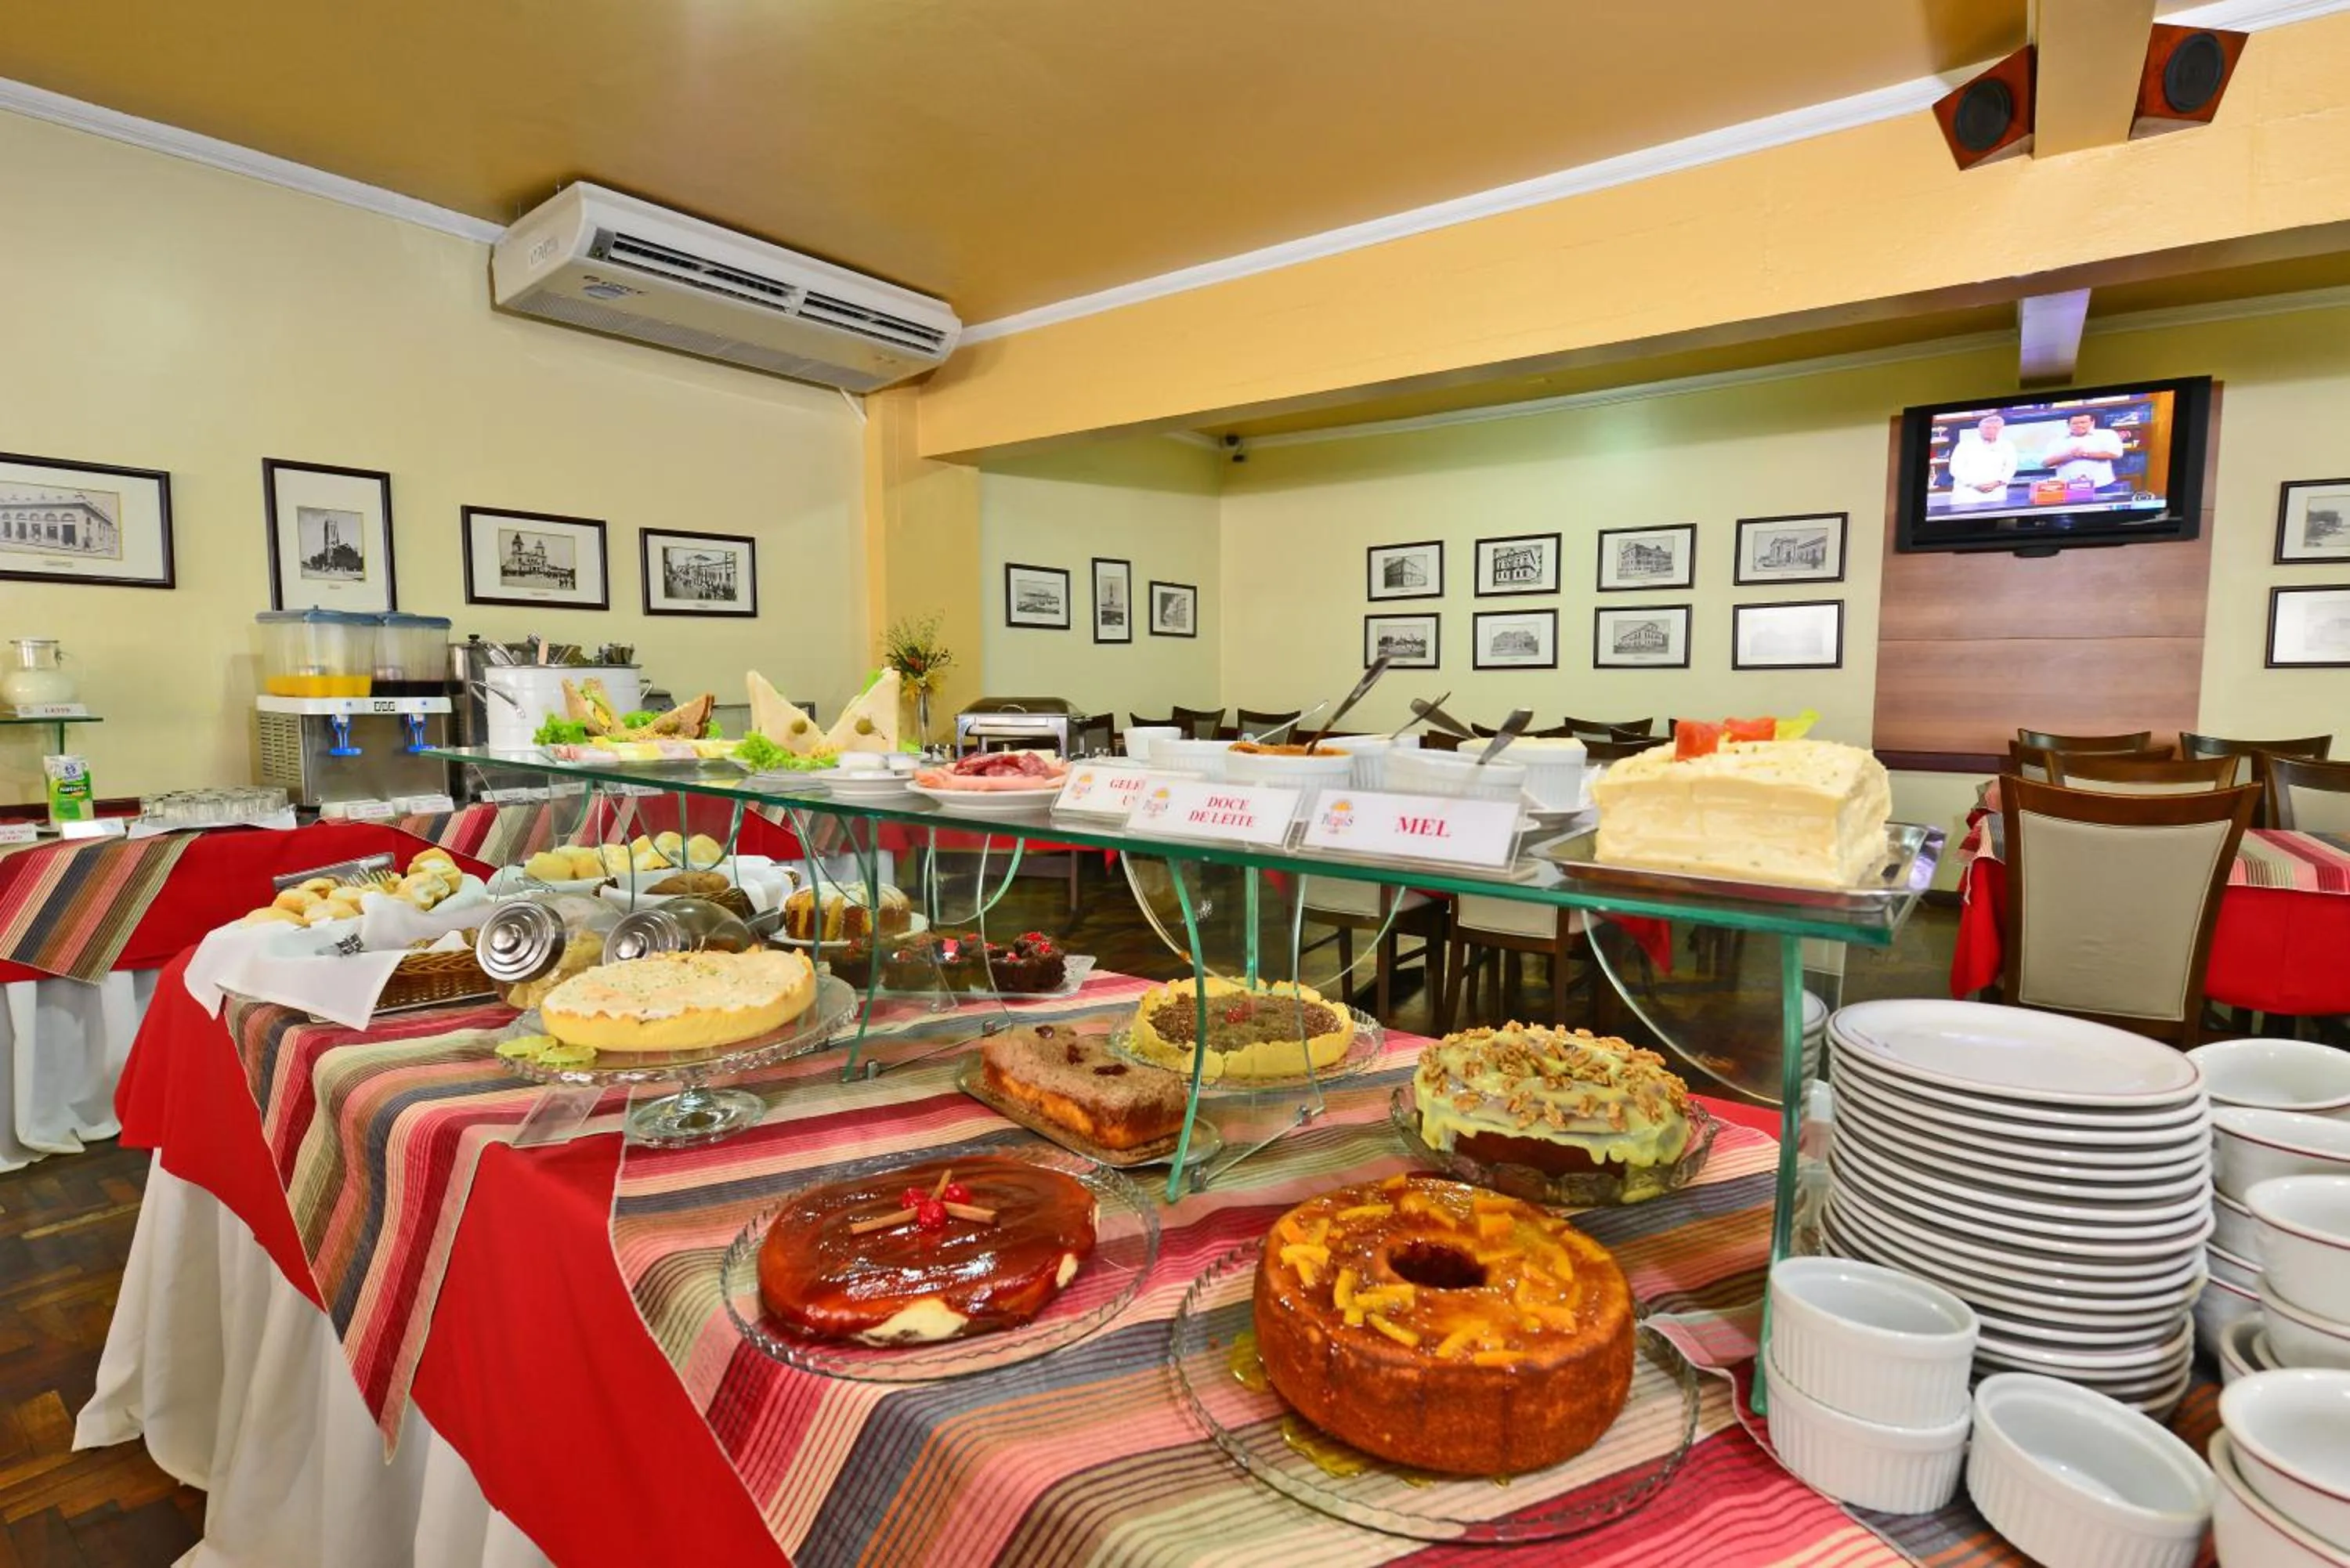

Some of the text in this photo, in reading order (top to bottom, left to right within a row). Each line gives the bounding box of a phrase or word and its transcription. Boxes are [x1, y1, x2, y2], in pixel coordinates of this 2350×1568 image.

[1206, 796, 1251, 811] DOCE
[1188, 809, 1256, 828] DE LEITE
[1394, 816, 1452, 838] MEL
